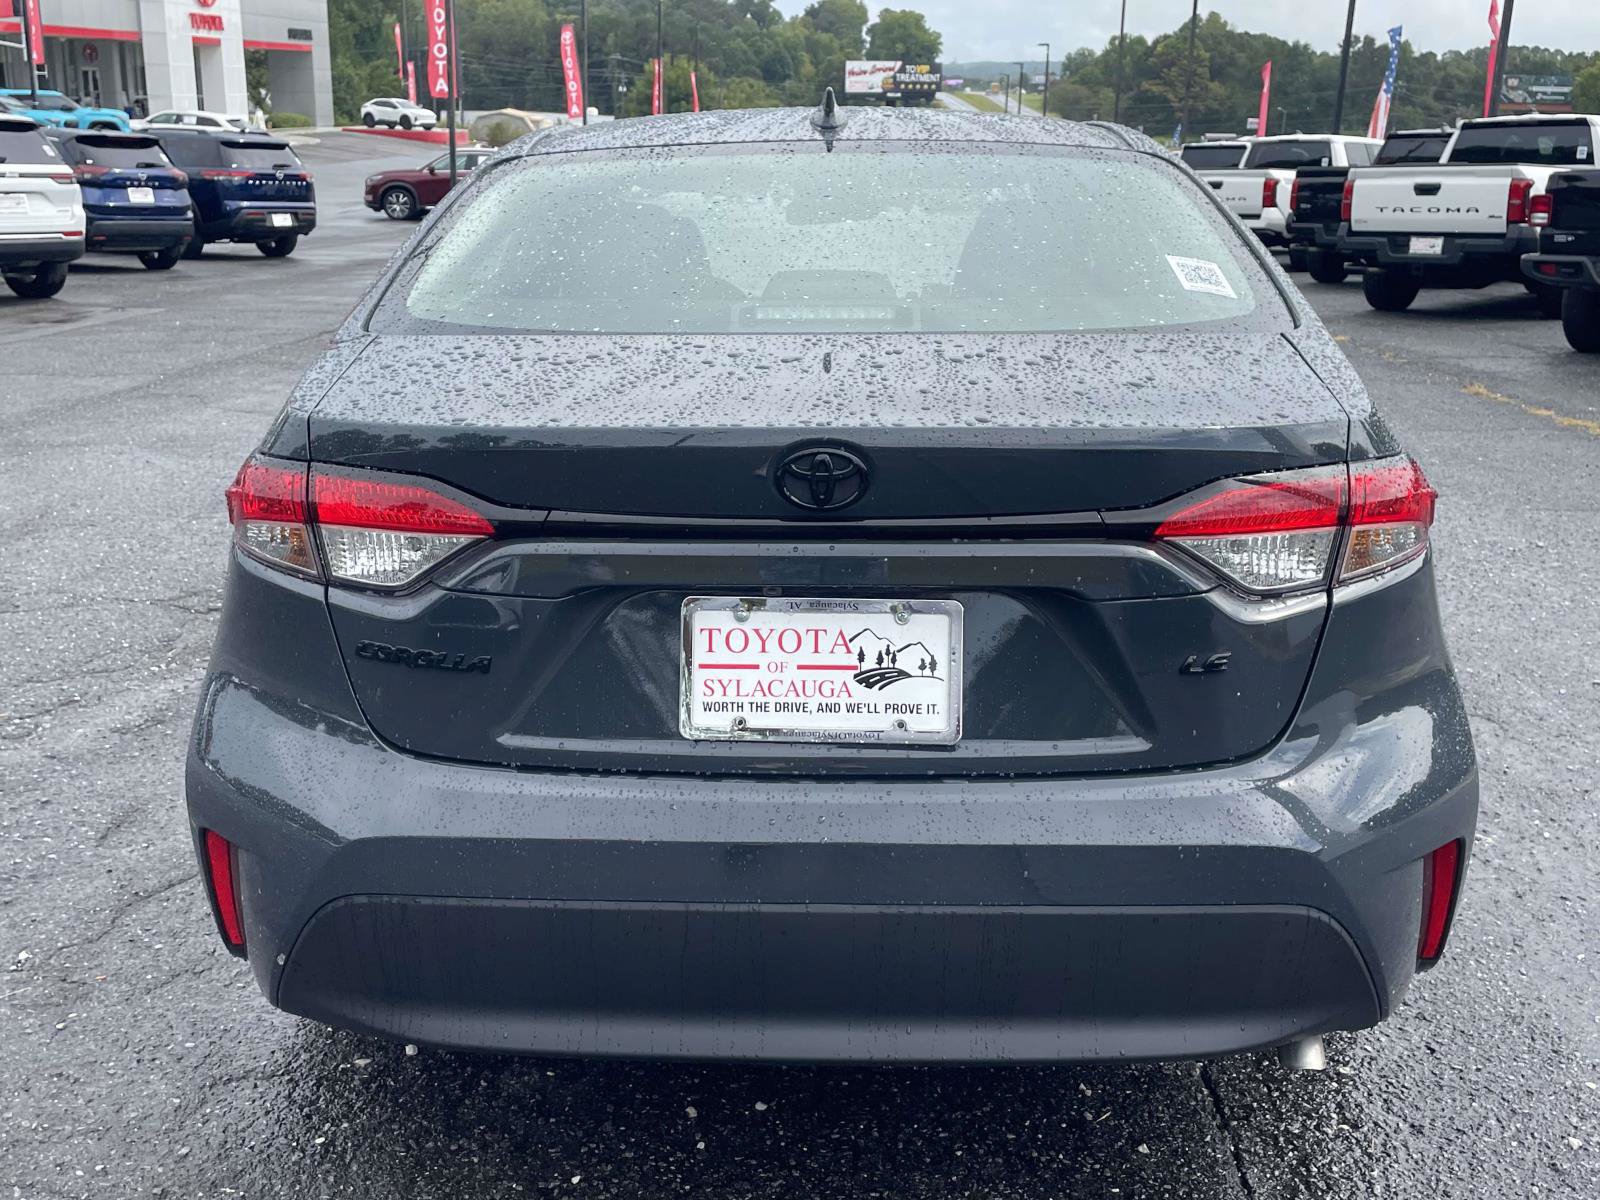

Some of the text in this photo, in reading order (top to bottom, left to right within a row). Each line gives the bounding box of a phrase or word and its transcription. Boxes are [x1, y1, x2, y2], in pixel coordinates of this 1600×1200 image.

[564, 45, 580, 115] TOYOTA
[896, 73, 940, 81] TREATMENT
[1375, 206, 1480, 214] TACOMA
[786, 601, 859, 612] Sylacauga, AL
[700, 627, 853, 655] TOYOTA
[356, 639, 492, 674] COROLLA
[1180, 652, 1232, 673] LE
[767, 661, 788, 674] OF
[703, 678, 853, 698] SYLACAUGA
[703, 701, 940, 715] WORTH THE DRIVE, AND WE'LL PROVE IT.
